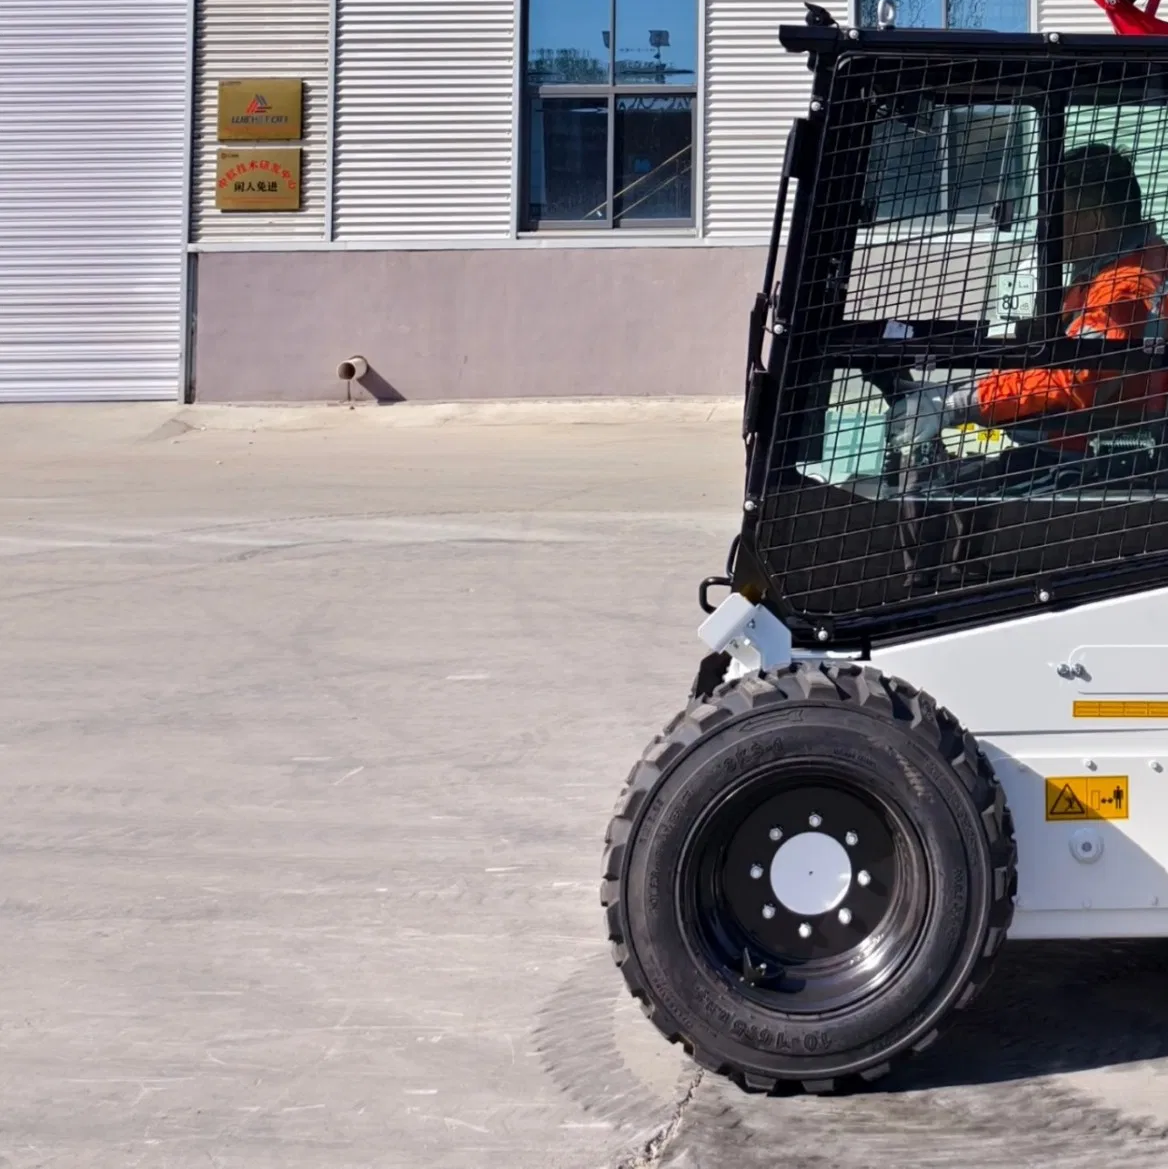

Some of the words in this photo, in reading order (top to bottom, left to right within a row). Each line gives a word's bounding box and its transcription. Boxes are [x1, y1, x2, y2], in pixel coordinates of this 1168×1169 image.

[234, 181, 278, 192] 闲人免进
[1002, 294, 1019, 310] 80
